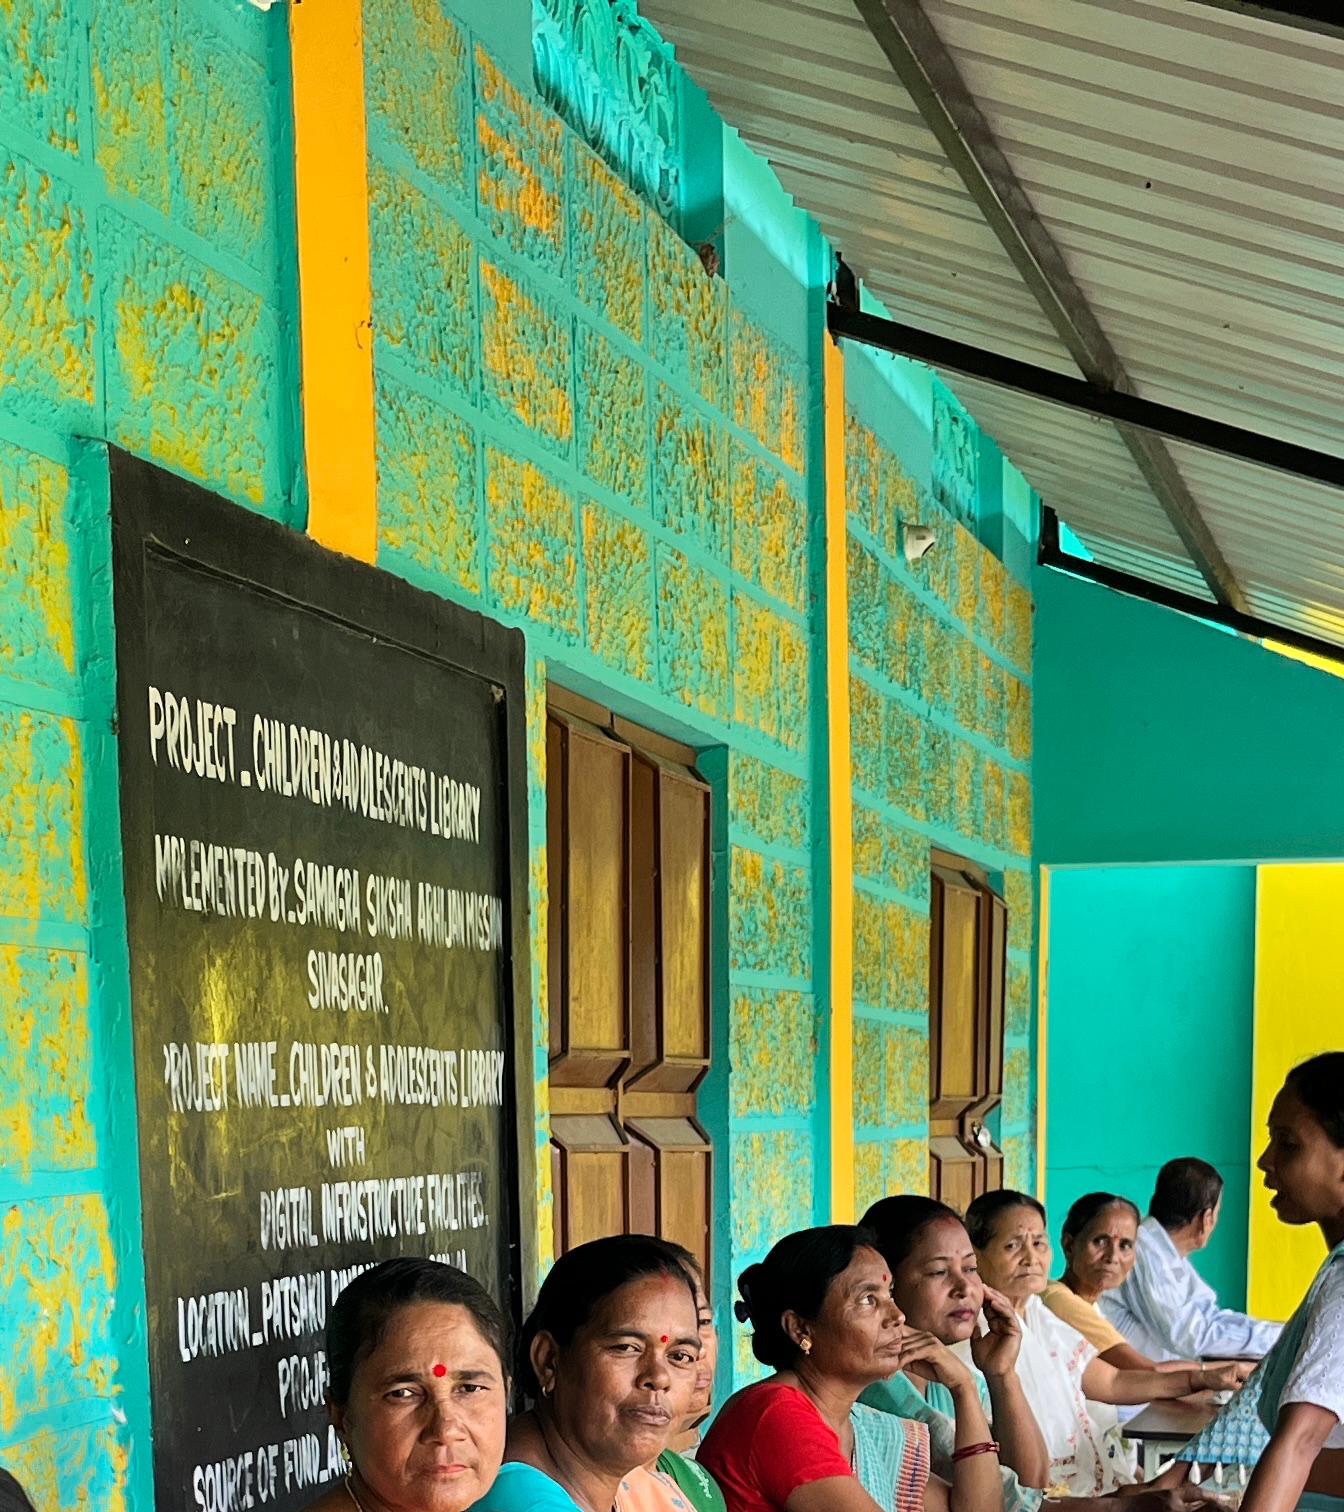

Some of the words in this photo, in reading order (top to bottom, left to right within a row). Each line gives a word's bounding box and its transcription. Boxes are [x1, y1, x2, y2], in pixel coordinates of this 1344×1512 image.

[149, 686, 236, 783] PROJECT
[431, 771, 480, 844] LIBRARY
[367, 874, 412, 941] SIKSHA
[365, 1045, 377, 1098] &
[380, 1045, 457, 1106] ADOLESCENTS
[461, 1049, 504, 1107] LIBRARY
[326, 1127, 365, 1168] WITH
[260, 1186, 318, 1249] DIGITAL
[322, 1176, 426, 1245] INFRASTRUCTURE
[257, 1444, 279, 1503] OF
